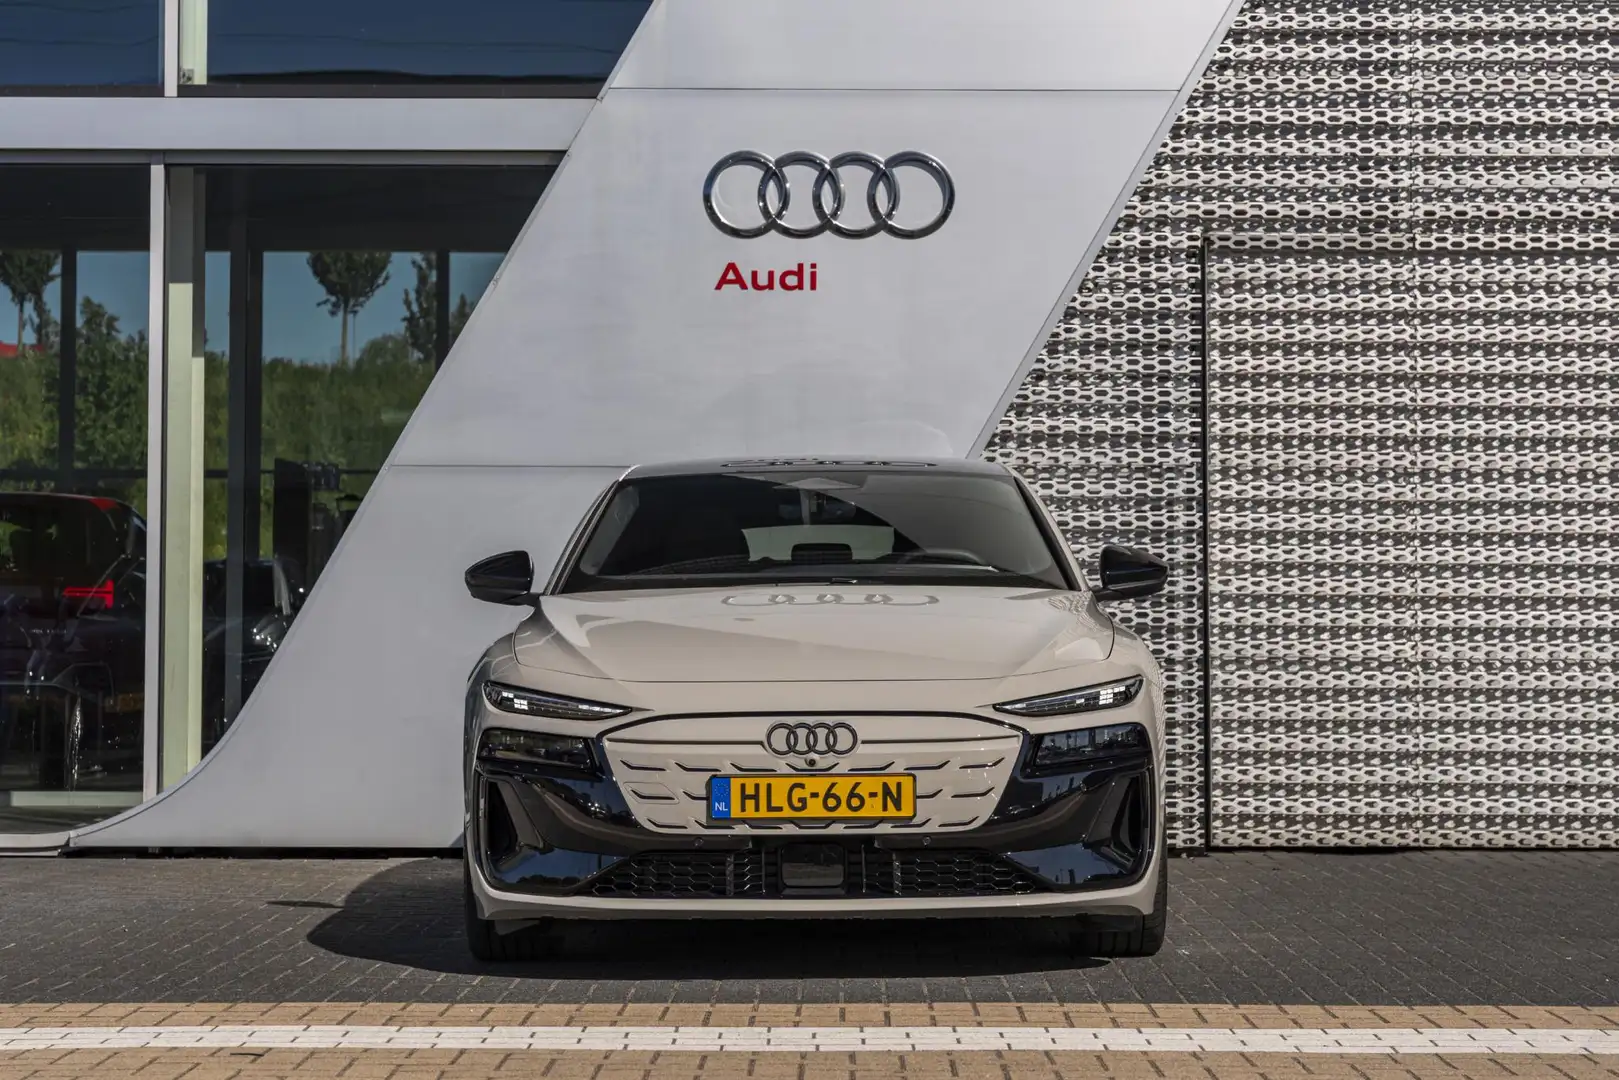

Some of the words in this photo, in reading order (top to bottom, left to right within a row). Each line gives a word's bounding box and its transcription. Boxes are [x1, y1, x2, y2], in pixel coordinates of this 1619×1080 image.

[714, 262, 818, 291] Audi
[714, 801, 729, 812] NL
[740, 781, 903, 813] HLG-66-N
